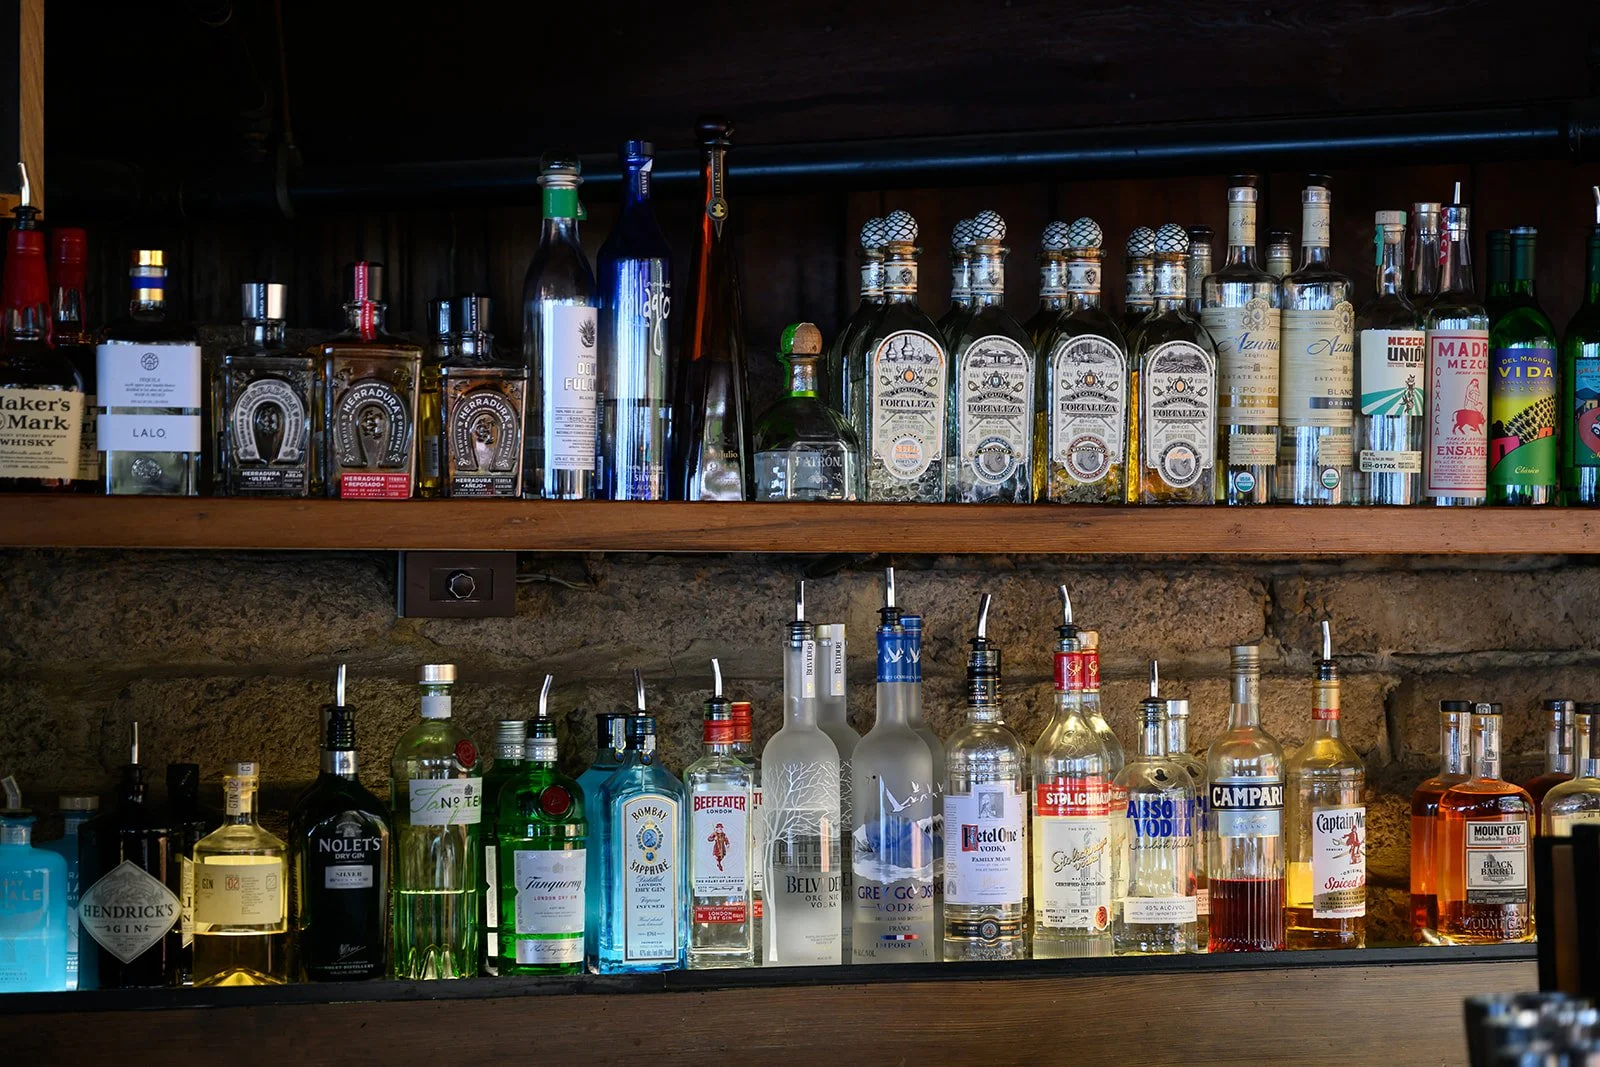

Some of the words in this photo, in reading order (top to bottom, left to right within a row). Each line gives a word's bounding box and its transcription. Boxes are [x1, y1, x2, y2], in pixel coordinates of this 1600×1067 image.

[1388, 337, 1424, 346] MEZCA
[1447, 359, 1488, 369] MEZCA
[1502, 357, 1518, 365] DEL
[1520, 355, 1551, 365] MAGUEY
[1498, 366, 1553, 378] VIDA
[0, 396, 71, 411] aker's
[343, 388, 401, 413] HERRADURA
[880, 400, 936, 408] FORTALEZA
[1434, 367, 1442, 436] OAXACA
[460, 398, 511, 422] HERRADURA
[968, 404, 1023, 413] FORTALEZA
[1061, 403, 1117, 412] FORTALEZA
[1153, 409, 1207, 418] FORTALEZA
[7, 414, 71, 430] Mark
[133, 428, 166, 438] LALO
[1437, 446, 1488, 456] ENSAMB
[796, 455, 840, 467] PATRÓN
[1212, 786, 1283, 807] CAMPARI
[694, 795, 746, 812] BEEFEATER
[632, 806, 669, 823] BOMBAY
[1316, 813, 1354, 834] Captain
[1474, 826, 1505, 836] MOUNT
[1507, 826, 1521, 835] GAY
[319, 836, 381, 852] NOLET'S
[964, 826, 998, 851] Ketel
[999, 827, 1017, 842] One
[1507, 836, 1521, 844] 1703
[629, 859, 672, 875] SAPPHIRE
[1483, 860, 1513, 868] BLACK
[202, 878, 214, 889] GIN
[525, 876, 582, 893] Tanqueray
[1324, 875, 1357, 891] Spiced
[858, 886, 890, 899] GREY
[83, 903, 174, 919] HENDRICK'S
[113, 925, 142, 933] GIN
